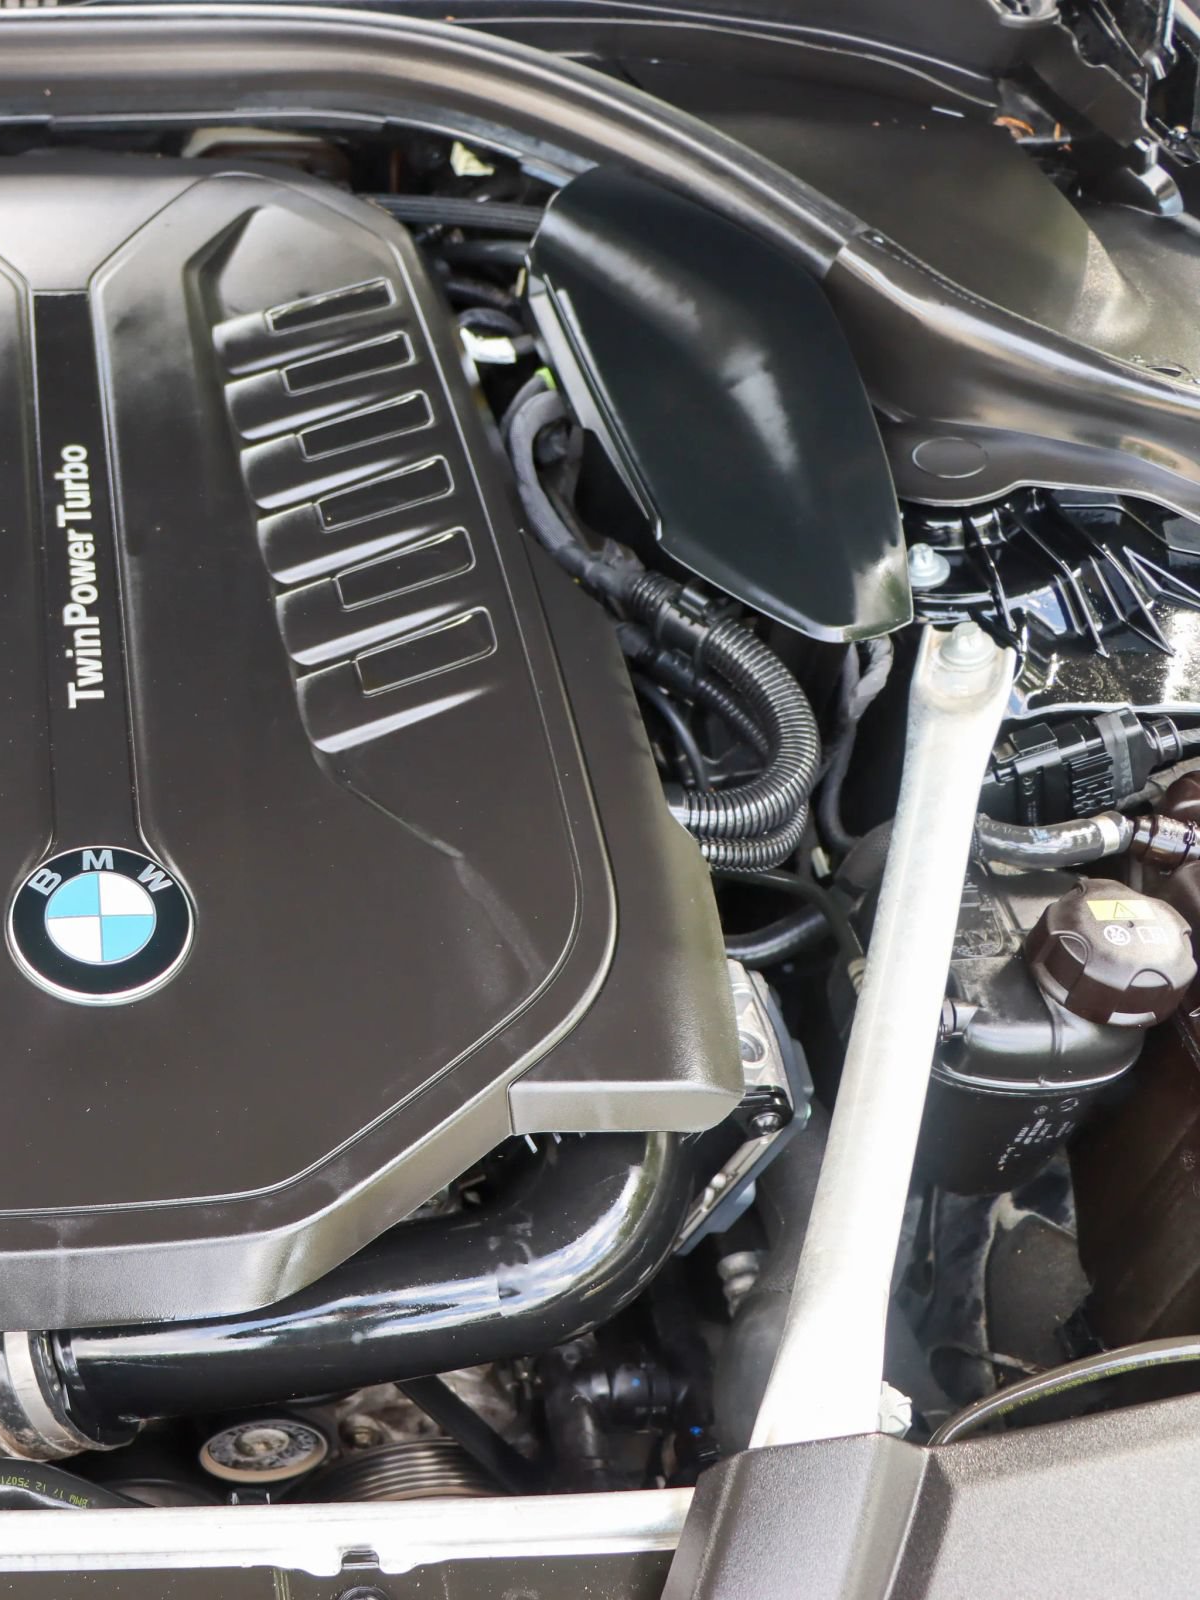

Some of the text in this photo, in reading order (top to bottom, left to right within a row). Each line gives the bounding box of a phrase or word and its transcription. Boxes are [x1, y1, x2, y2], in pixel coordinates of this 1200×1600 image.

[54, 444, 105, 710] TwinPower Turbo
[27, 849, 173, 896] BMW
